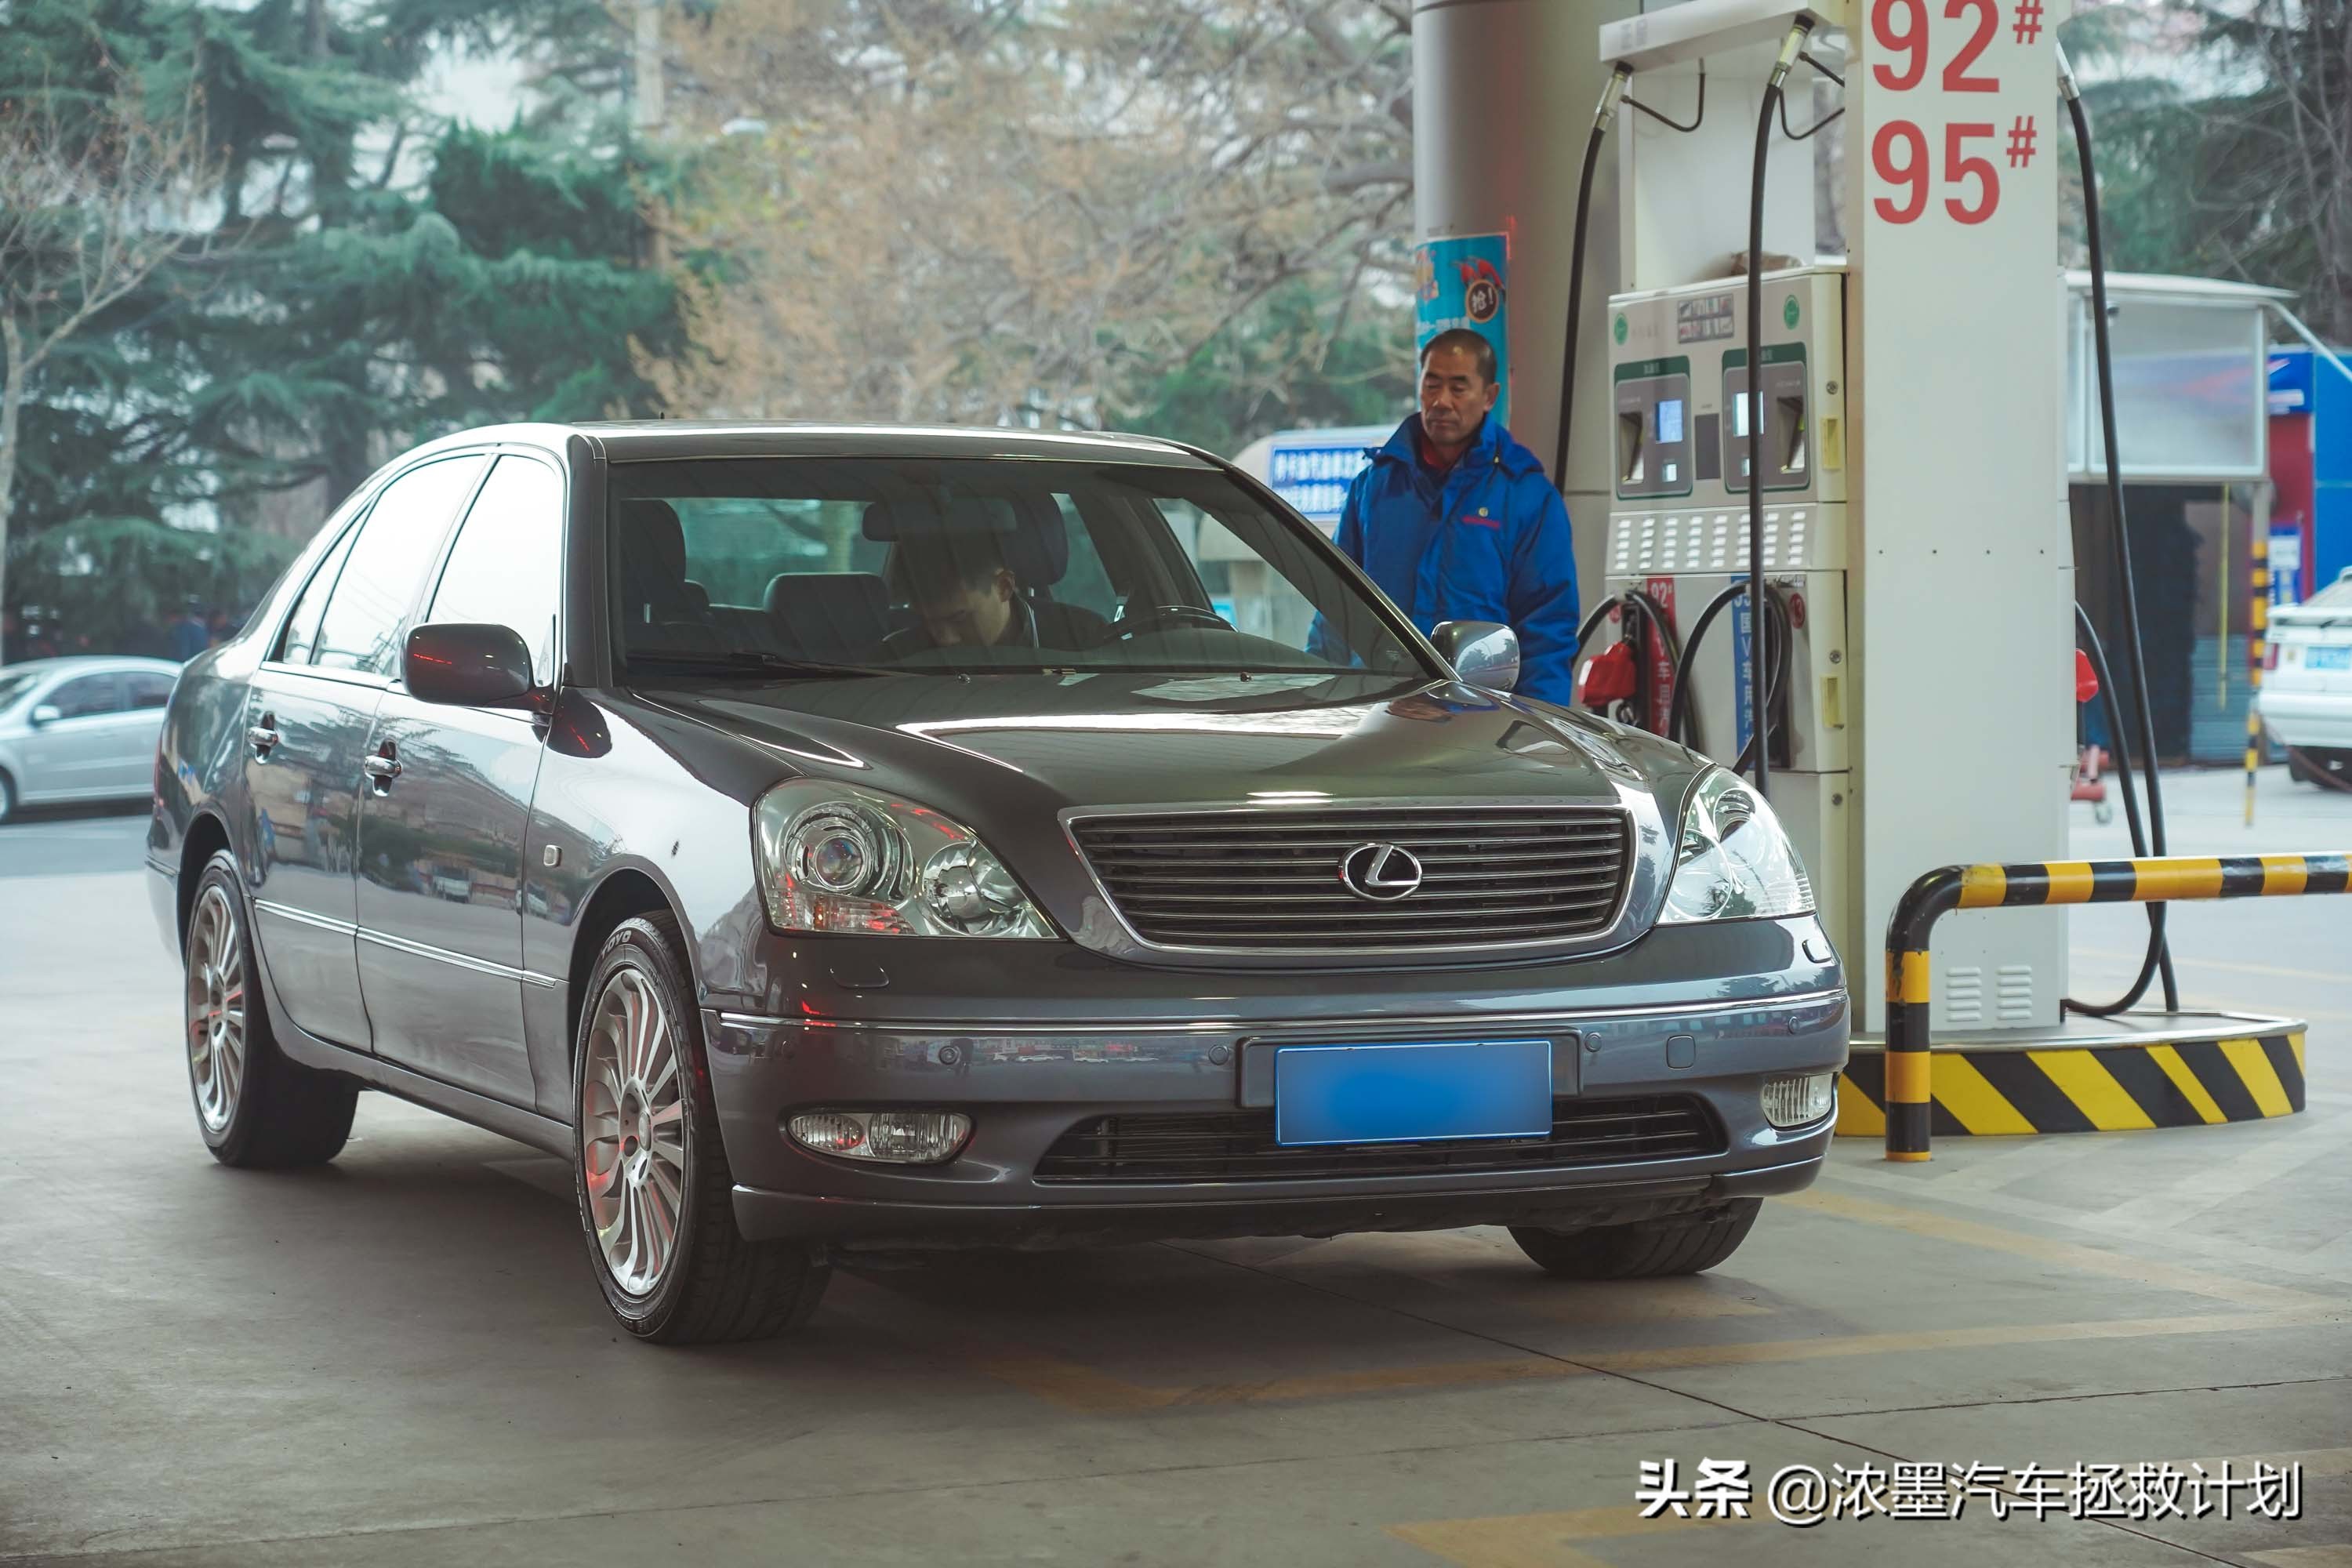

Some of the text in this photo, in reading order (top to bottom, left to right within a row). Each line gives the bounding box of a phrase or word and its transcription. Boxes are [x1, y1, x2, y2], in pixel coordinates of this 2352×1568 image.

[1871, 0, 2043, 93] 92#
[1871, 115, 2037, 225] 95#
[601, 930, 632, 959] TOYO
